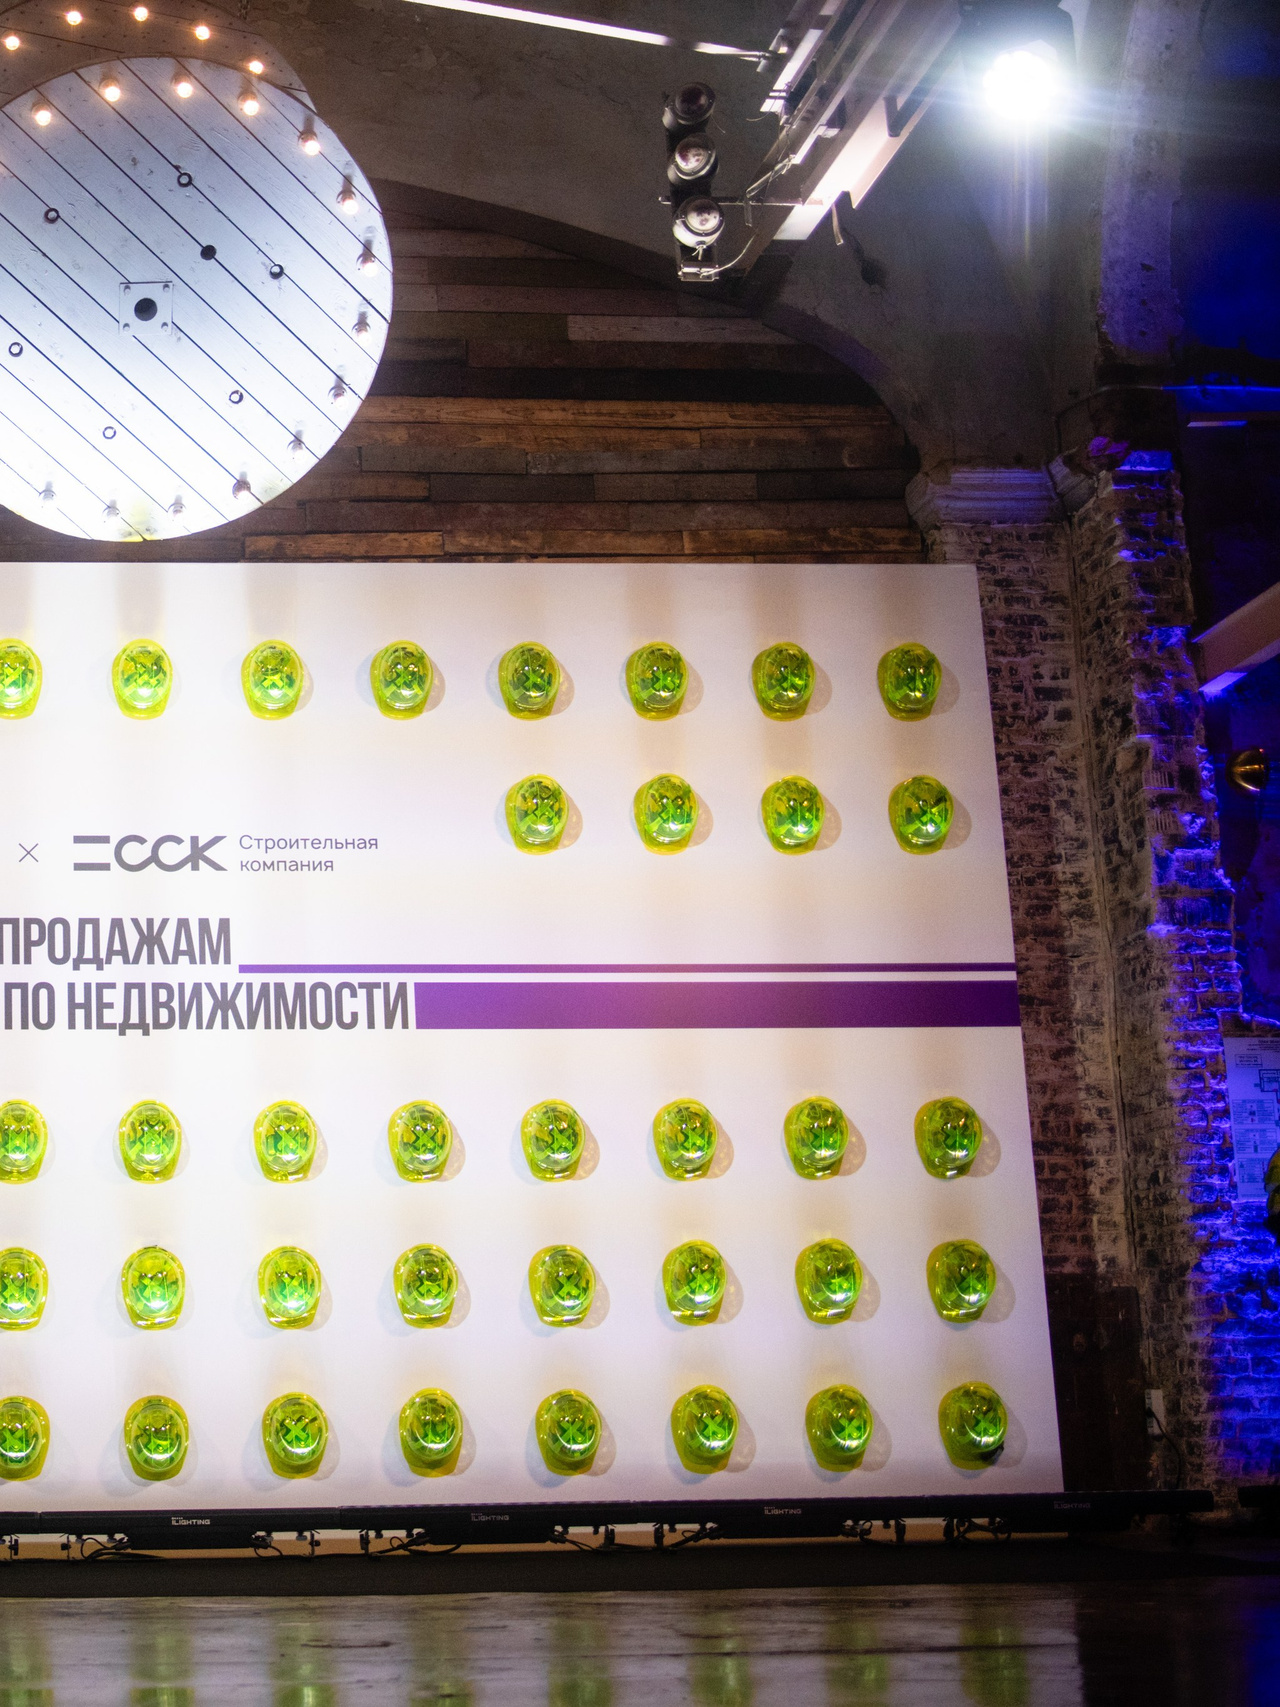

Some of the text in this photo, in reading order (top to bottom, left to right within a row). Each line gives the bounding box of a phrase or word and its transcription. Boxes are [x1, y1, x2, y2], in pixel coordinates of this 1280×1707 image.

[238, 834, 379, 853] Строительная
[240, 860, 334, 872] компания
[4, 981, 56, 1030] ПО
[67, 981, 409, 1036] НЕДВИЖИМОСТИ
